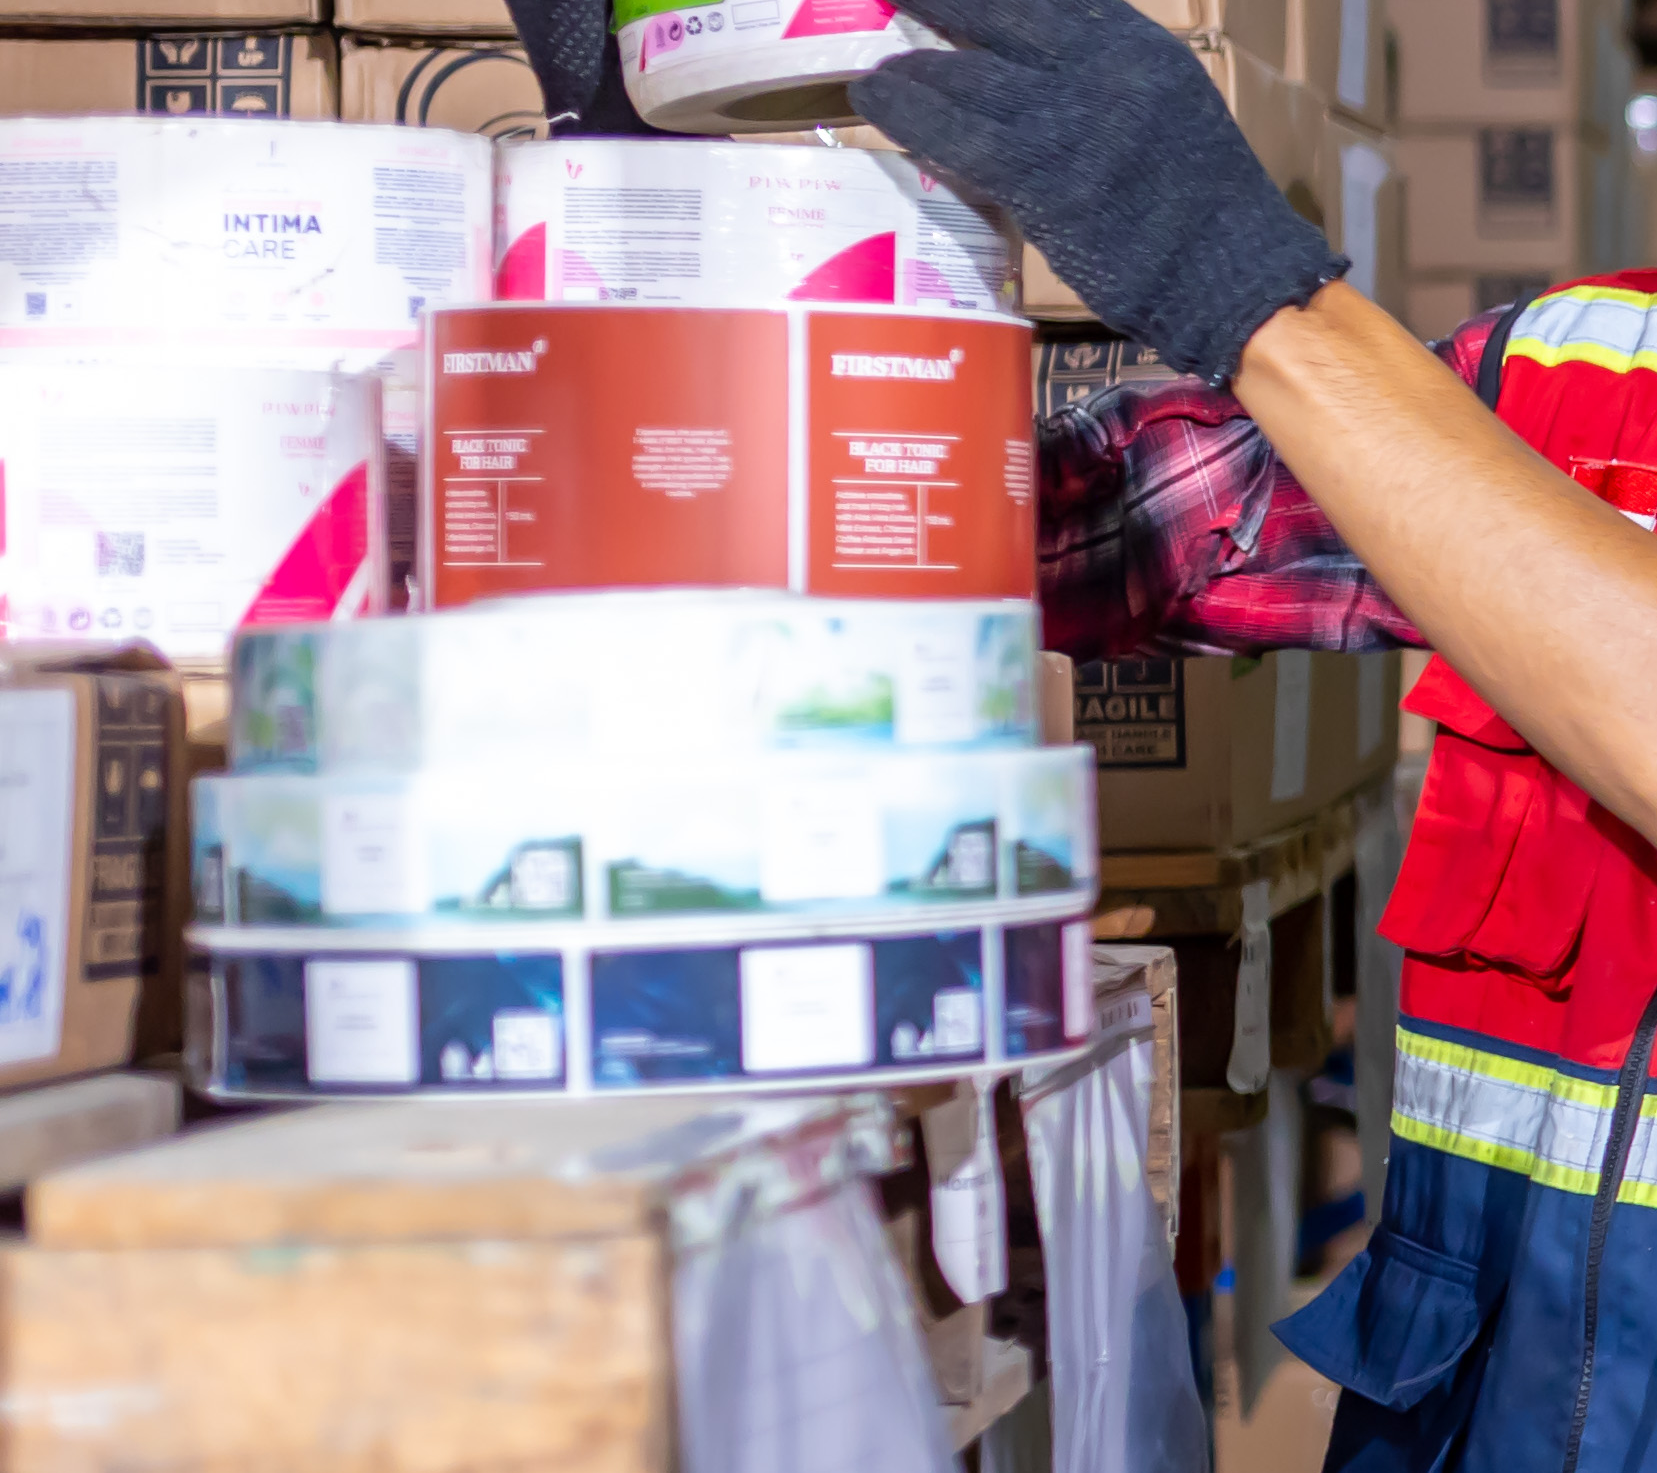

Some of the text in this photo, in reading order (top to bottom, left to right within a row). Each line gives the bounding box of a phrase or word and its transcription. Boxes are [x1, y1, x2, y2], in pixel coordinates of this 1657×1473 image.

[223, 212, 323, 235] INTIMA
[222, 238, 296, 260] CARE
[443, 350, 537, 373] FIRSTMAN
[830, 354, 955, 381] FIRSTMAN
[849, 441, 948, 459] BLACK TONIC
[482, 455, 517, 470] HAIR
[865, 458, 937, 474] FOR HAIR
